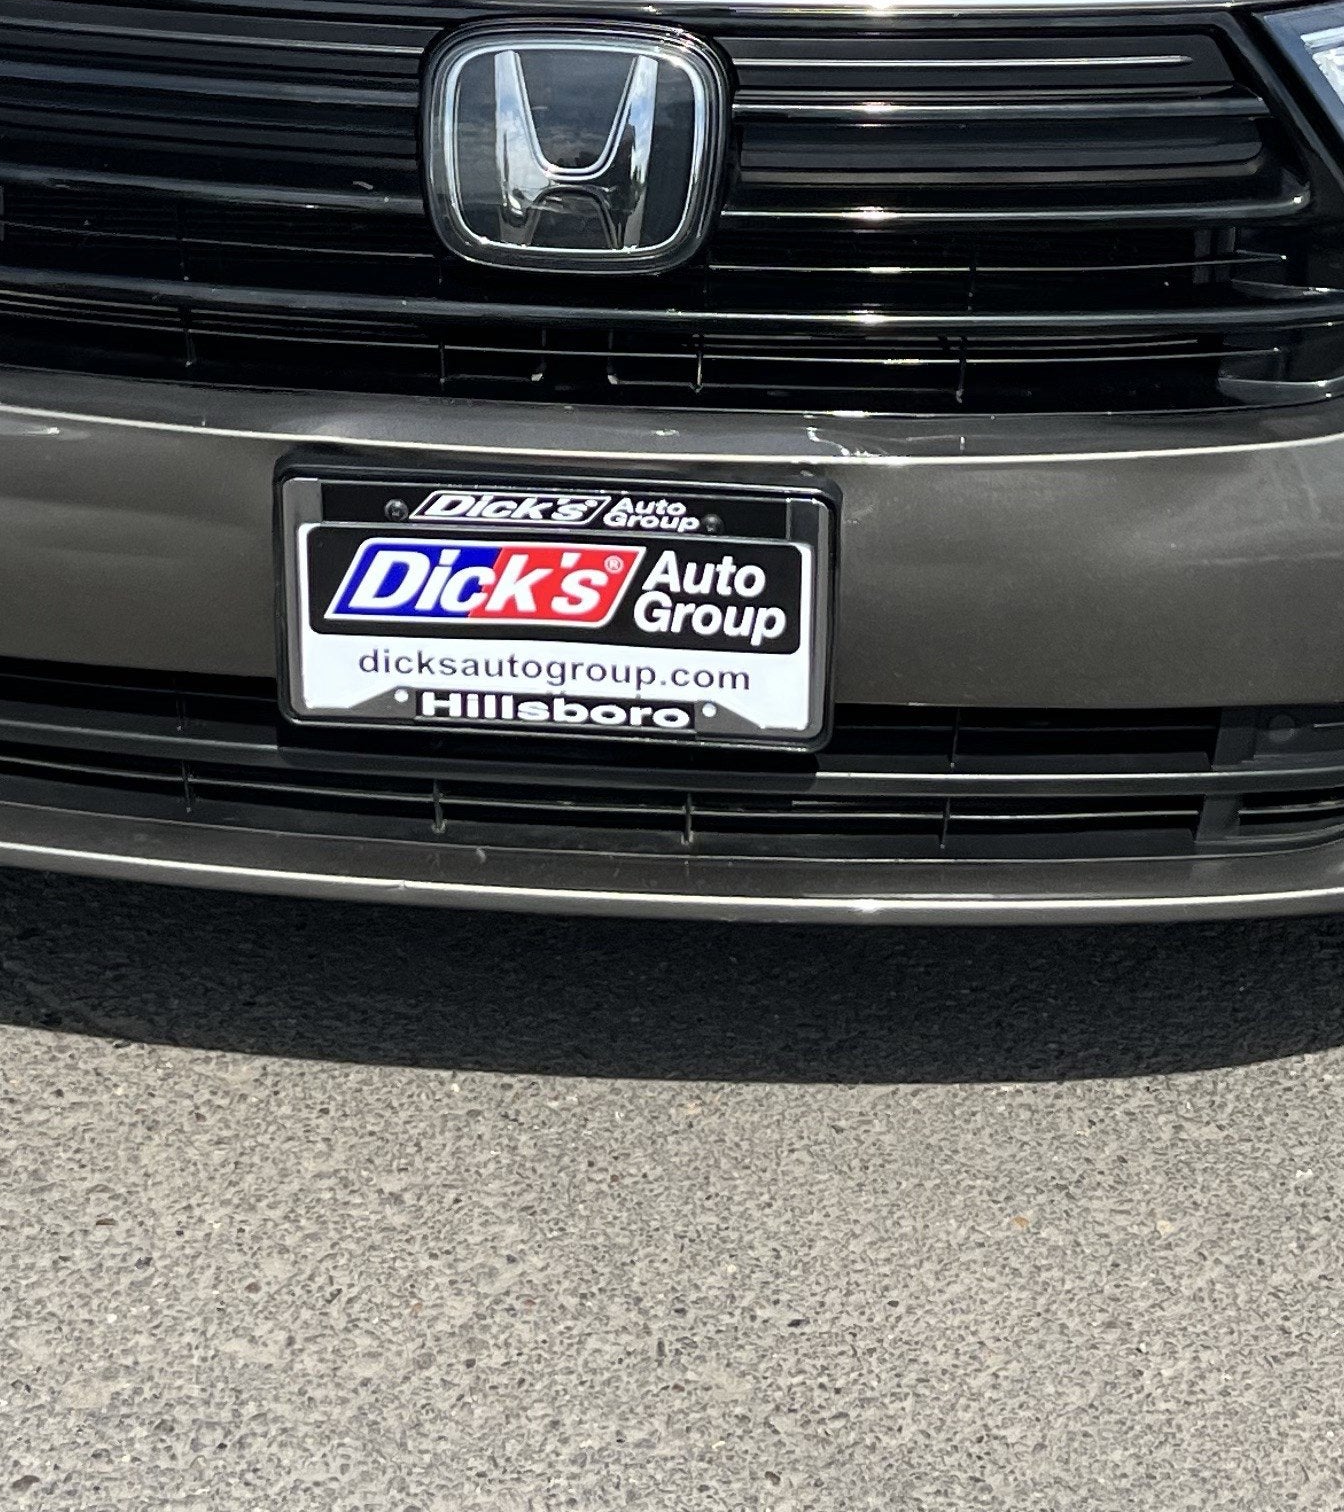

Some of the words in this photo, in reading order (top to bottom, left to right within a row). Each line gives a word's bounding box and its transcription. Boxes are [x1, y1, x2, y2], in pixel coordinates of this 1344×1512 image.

[424, 494, 583, 522] Dick's
[602, 513, 701, 533] Group
[609, 497, 687, 517] Auto
[348, 548, 608, 615] Dick's
[642, 549, 767, 598] Auto
[632, 591, 787, 646] Group
[358, 649, 750, 690] dicksautogroup.com
[422, 691, 691, 728] Hillsboro
